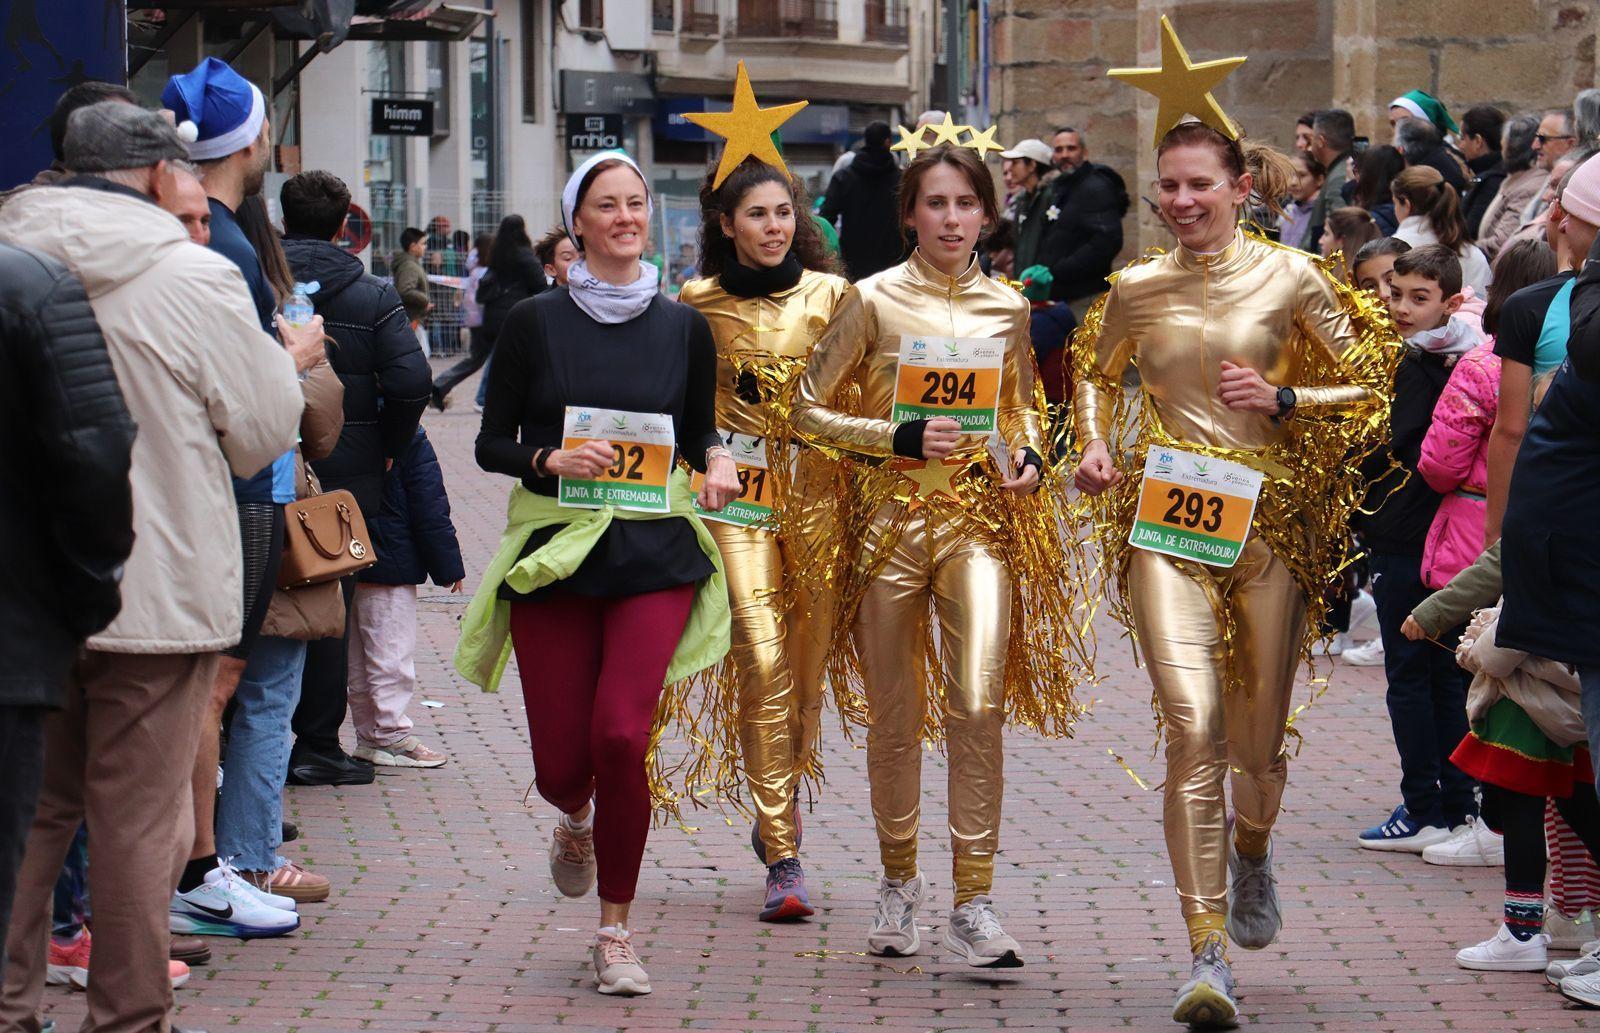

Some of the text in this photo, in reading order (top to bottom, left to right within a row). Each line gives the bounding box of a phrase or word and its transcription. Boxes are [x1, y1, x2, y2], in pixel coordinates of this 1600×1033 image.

[384, 104, 422, 120] himm
[920, 371, 976, 406] 294
[898, 410, 920, 421] JUNTA
[608, 444, 645, 480] 92
[565, 486, 663, 503] JUNTA DE EXTREMADURA
[736, 468, 766, 501] 81
[1182, 472, 1218, 486] Extremadura
[1163, 488, 1224, 532] 293
[1137, 528, 1235, 559] JUNTA DE EXTREMADURA
